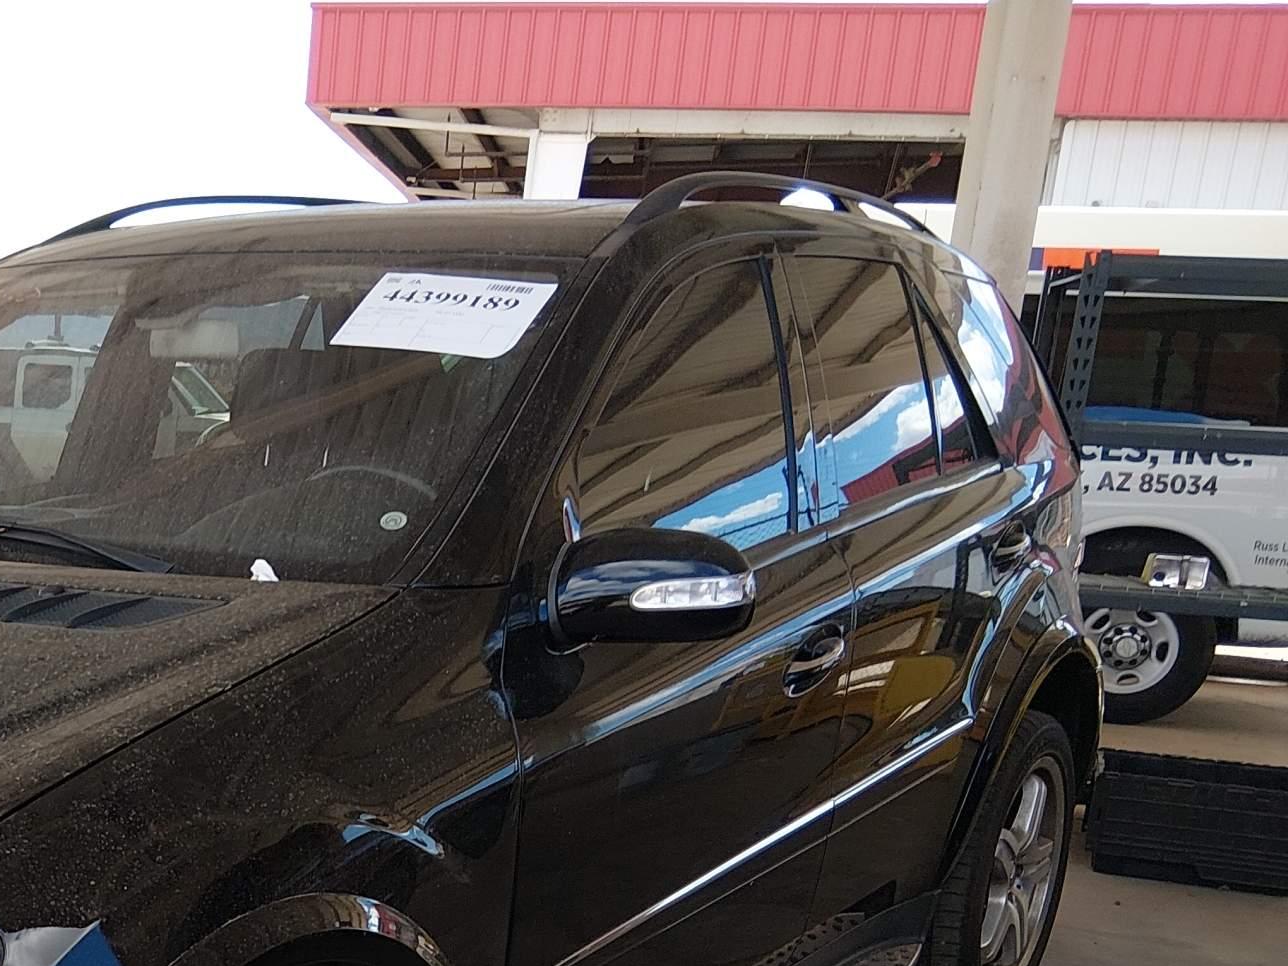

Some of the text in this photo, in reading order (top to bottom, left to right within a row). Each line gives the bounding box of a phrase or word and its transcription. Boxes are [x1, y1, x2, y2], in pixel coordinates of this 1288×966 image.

[383, 288, 521, 312] 44399189
[1097, 471, 1133, 492] AZ
[1139, 473, 1218, 496] 85034
[1253, 540, 1279, 551] Russ
[1255, 554, 1288, 567] Intern
